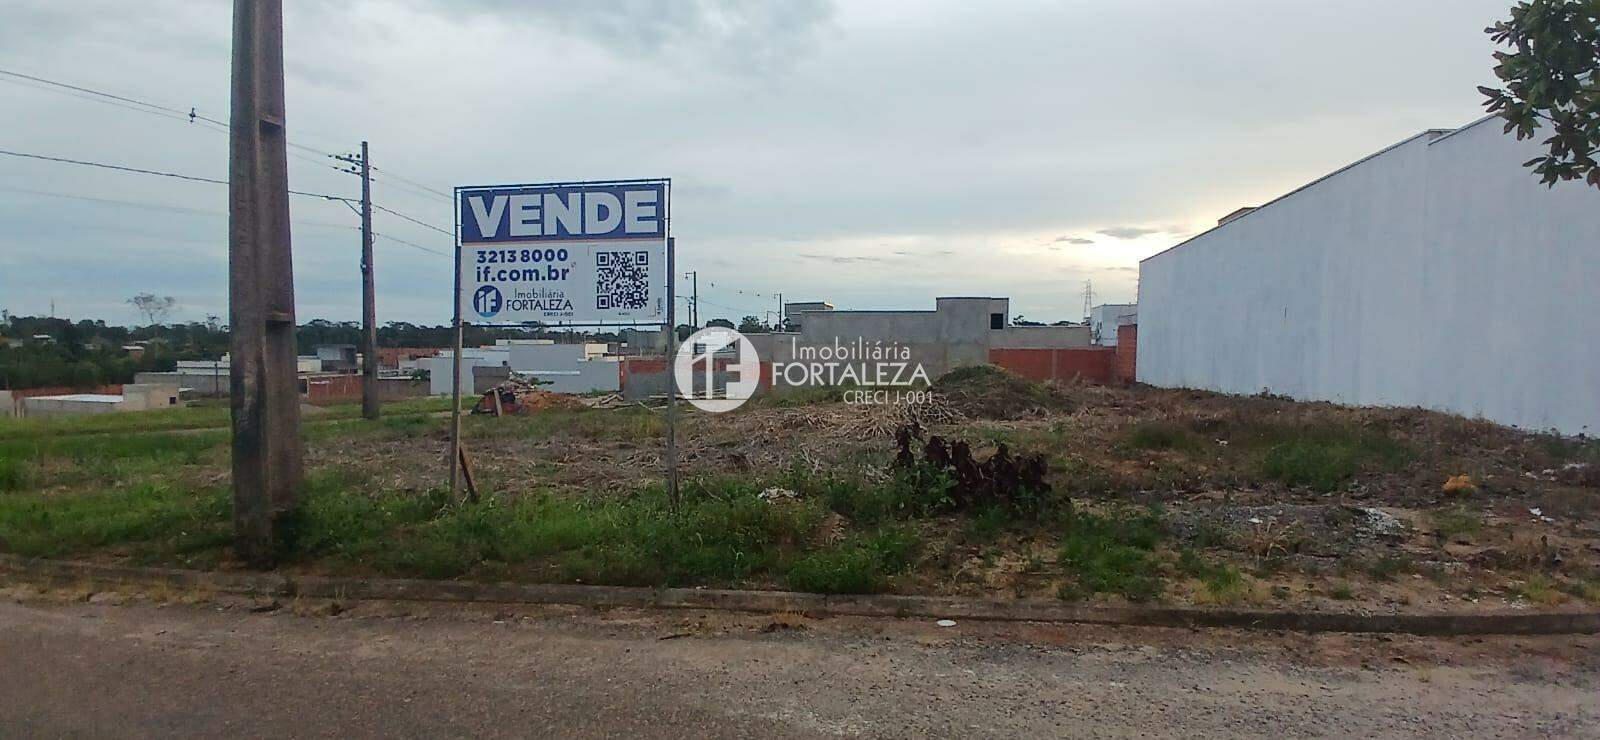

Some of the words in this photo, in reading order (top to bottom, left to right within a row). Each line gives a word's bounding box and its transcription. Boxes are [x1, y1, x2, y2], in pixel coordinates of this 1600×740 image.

[468, 190, 658, 238] VENDE
[477, 250, 517, 263] 3213
[520, 248, 568, 263] 8000
[476, 264, 570, 282] if.com.br
[506, 299, 574, 311] FORTALEZA
